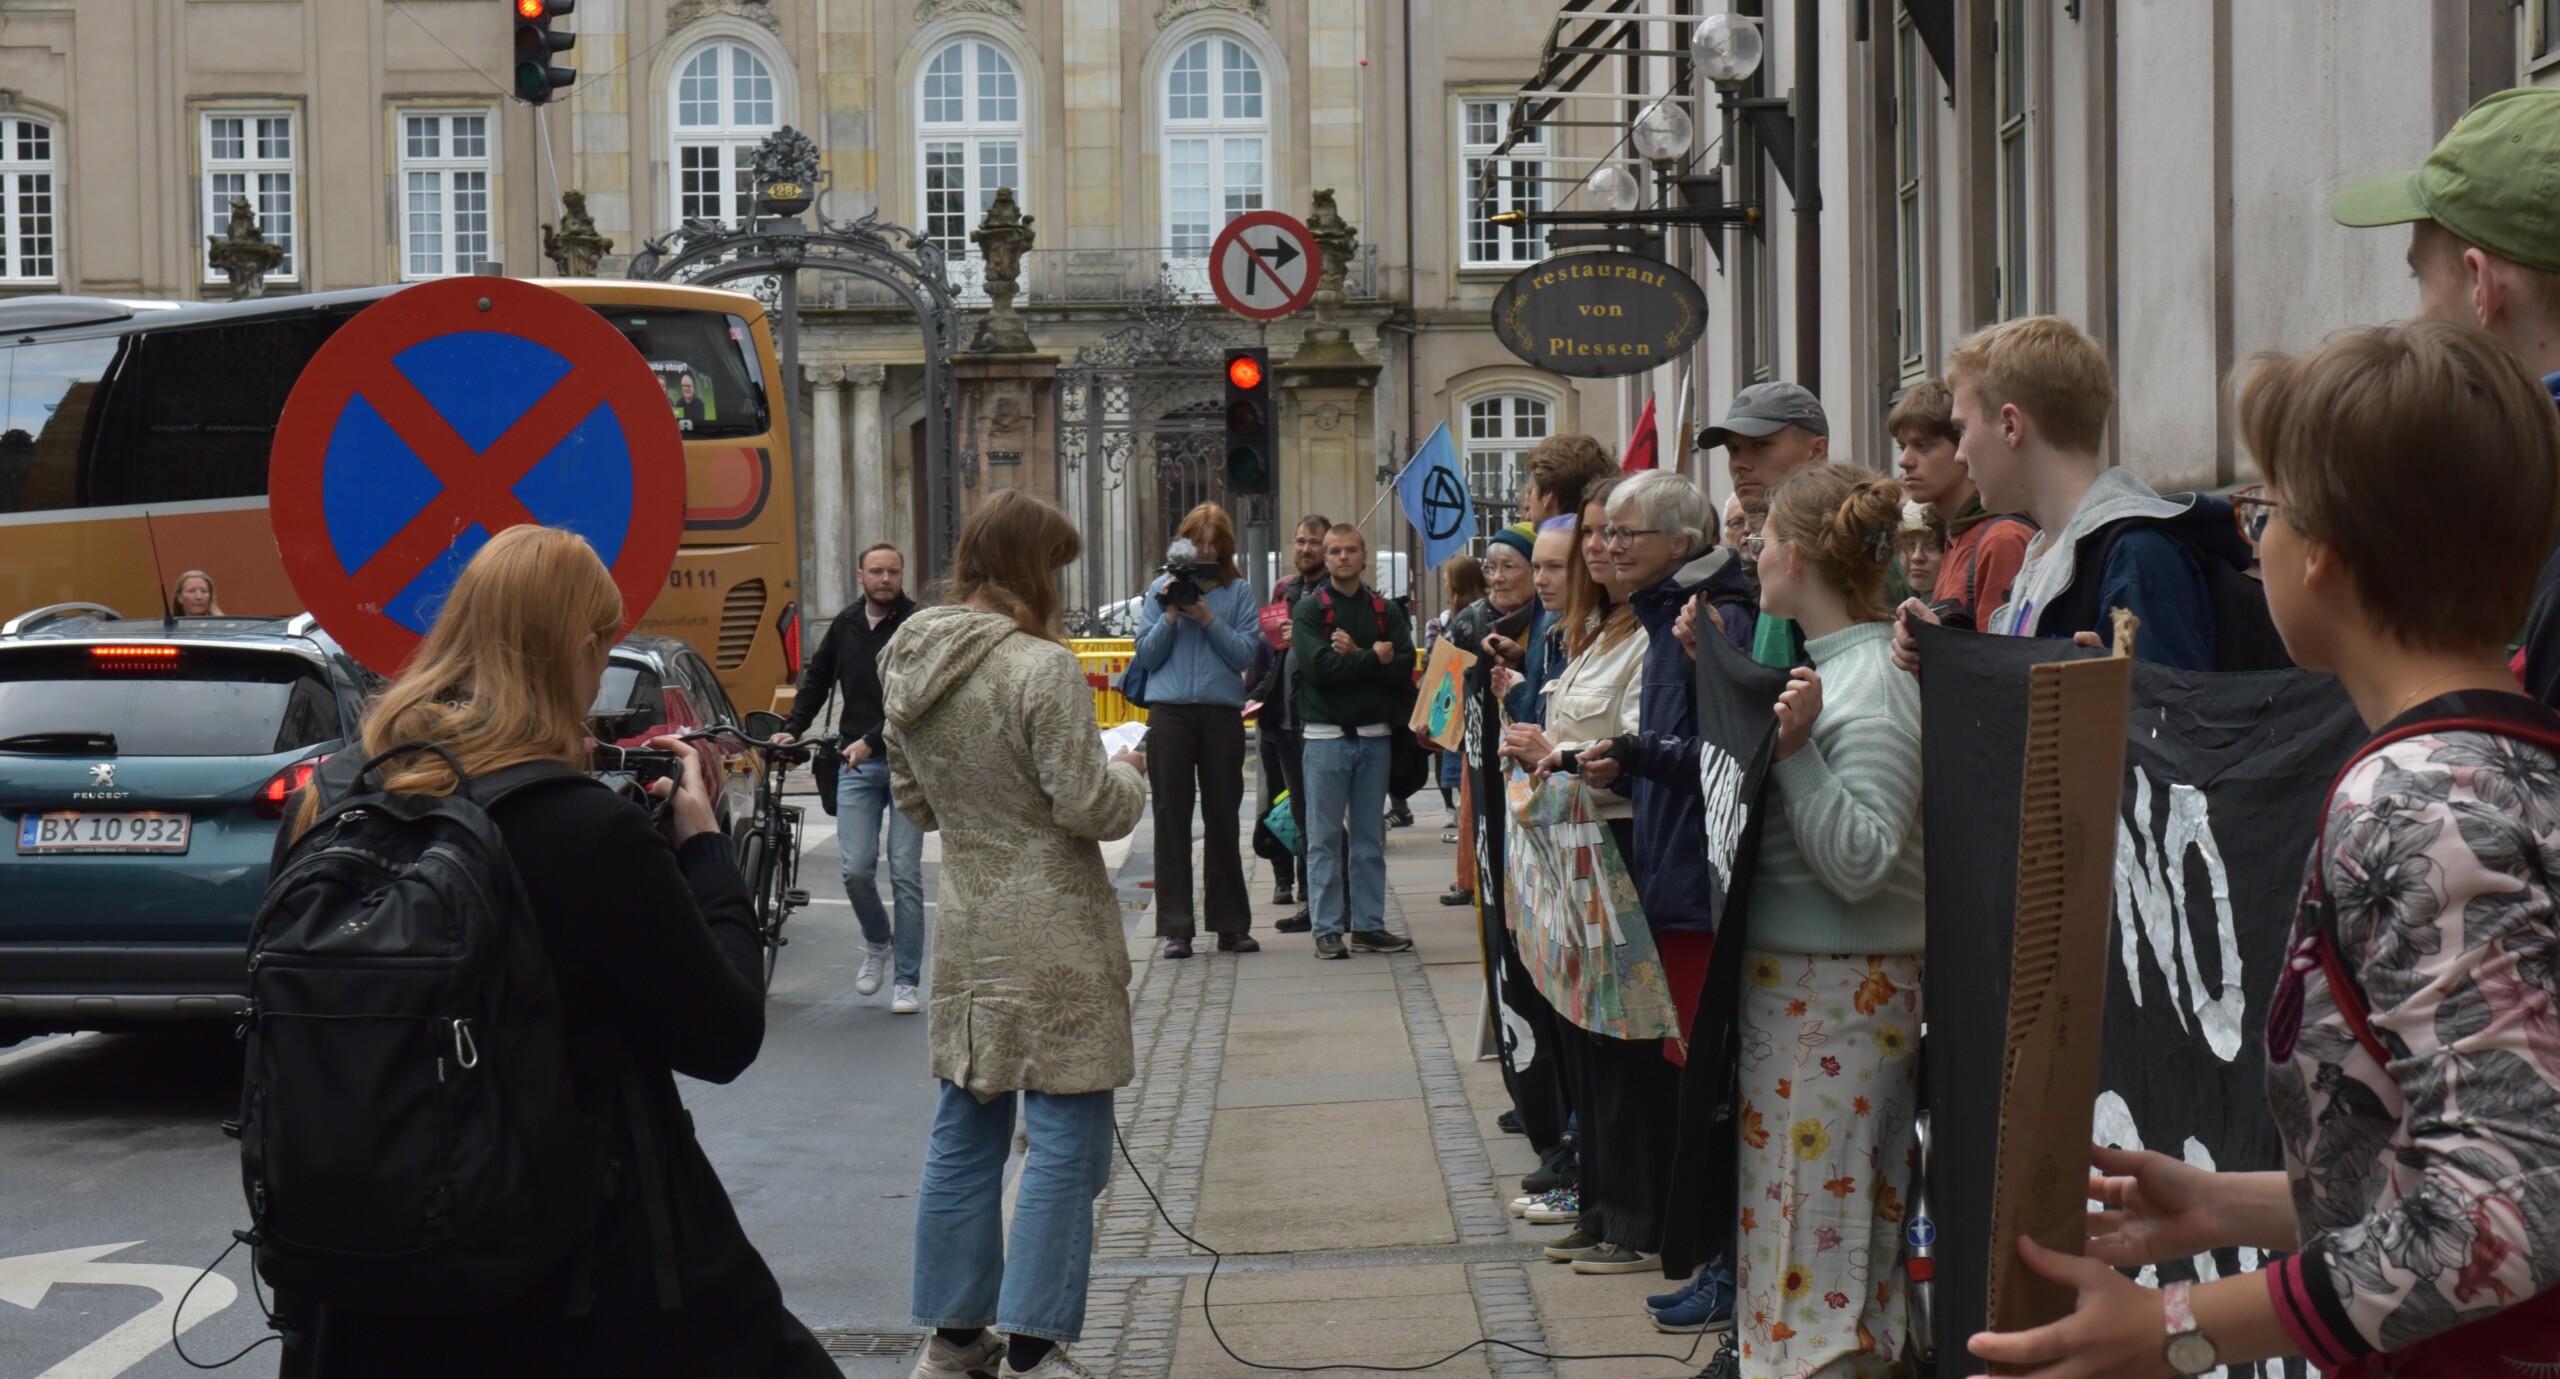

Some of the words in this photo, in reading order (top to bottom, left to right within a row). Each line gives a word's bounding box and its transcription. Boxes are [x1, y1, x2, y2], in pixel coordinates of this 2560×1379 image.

[776, 185, 793, 197] 28
[1532, 264, 1667, 289] restaurant
[1578, 304, 1623, 317] von
[1549, 338, 1651, 356] Plessen
[665, 363, 688, 373] stop?
[40, 818, 80, 842] BX
[89, 818, 122, 842] 10
[130, 818, 184, 842] 932
